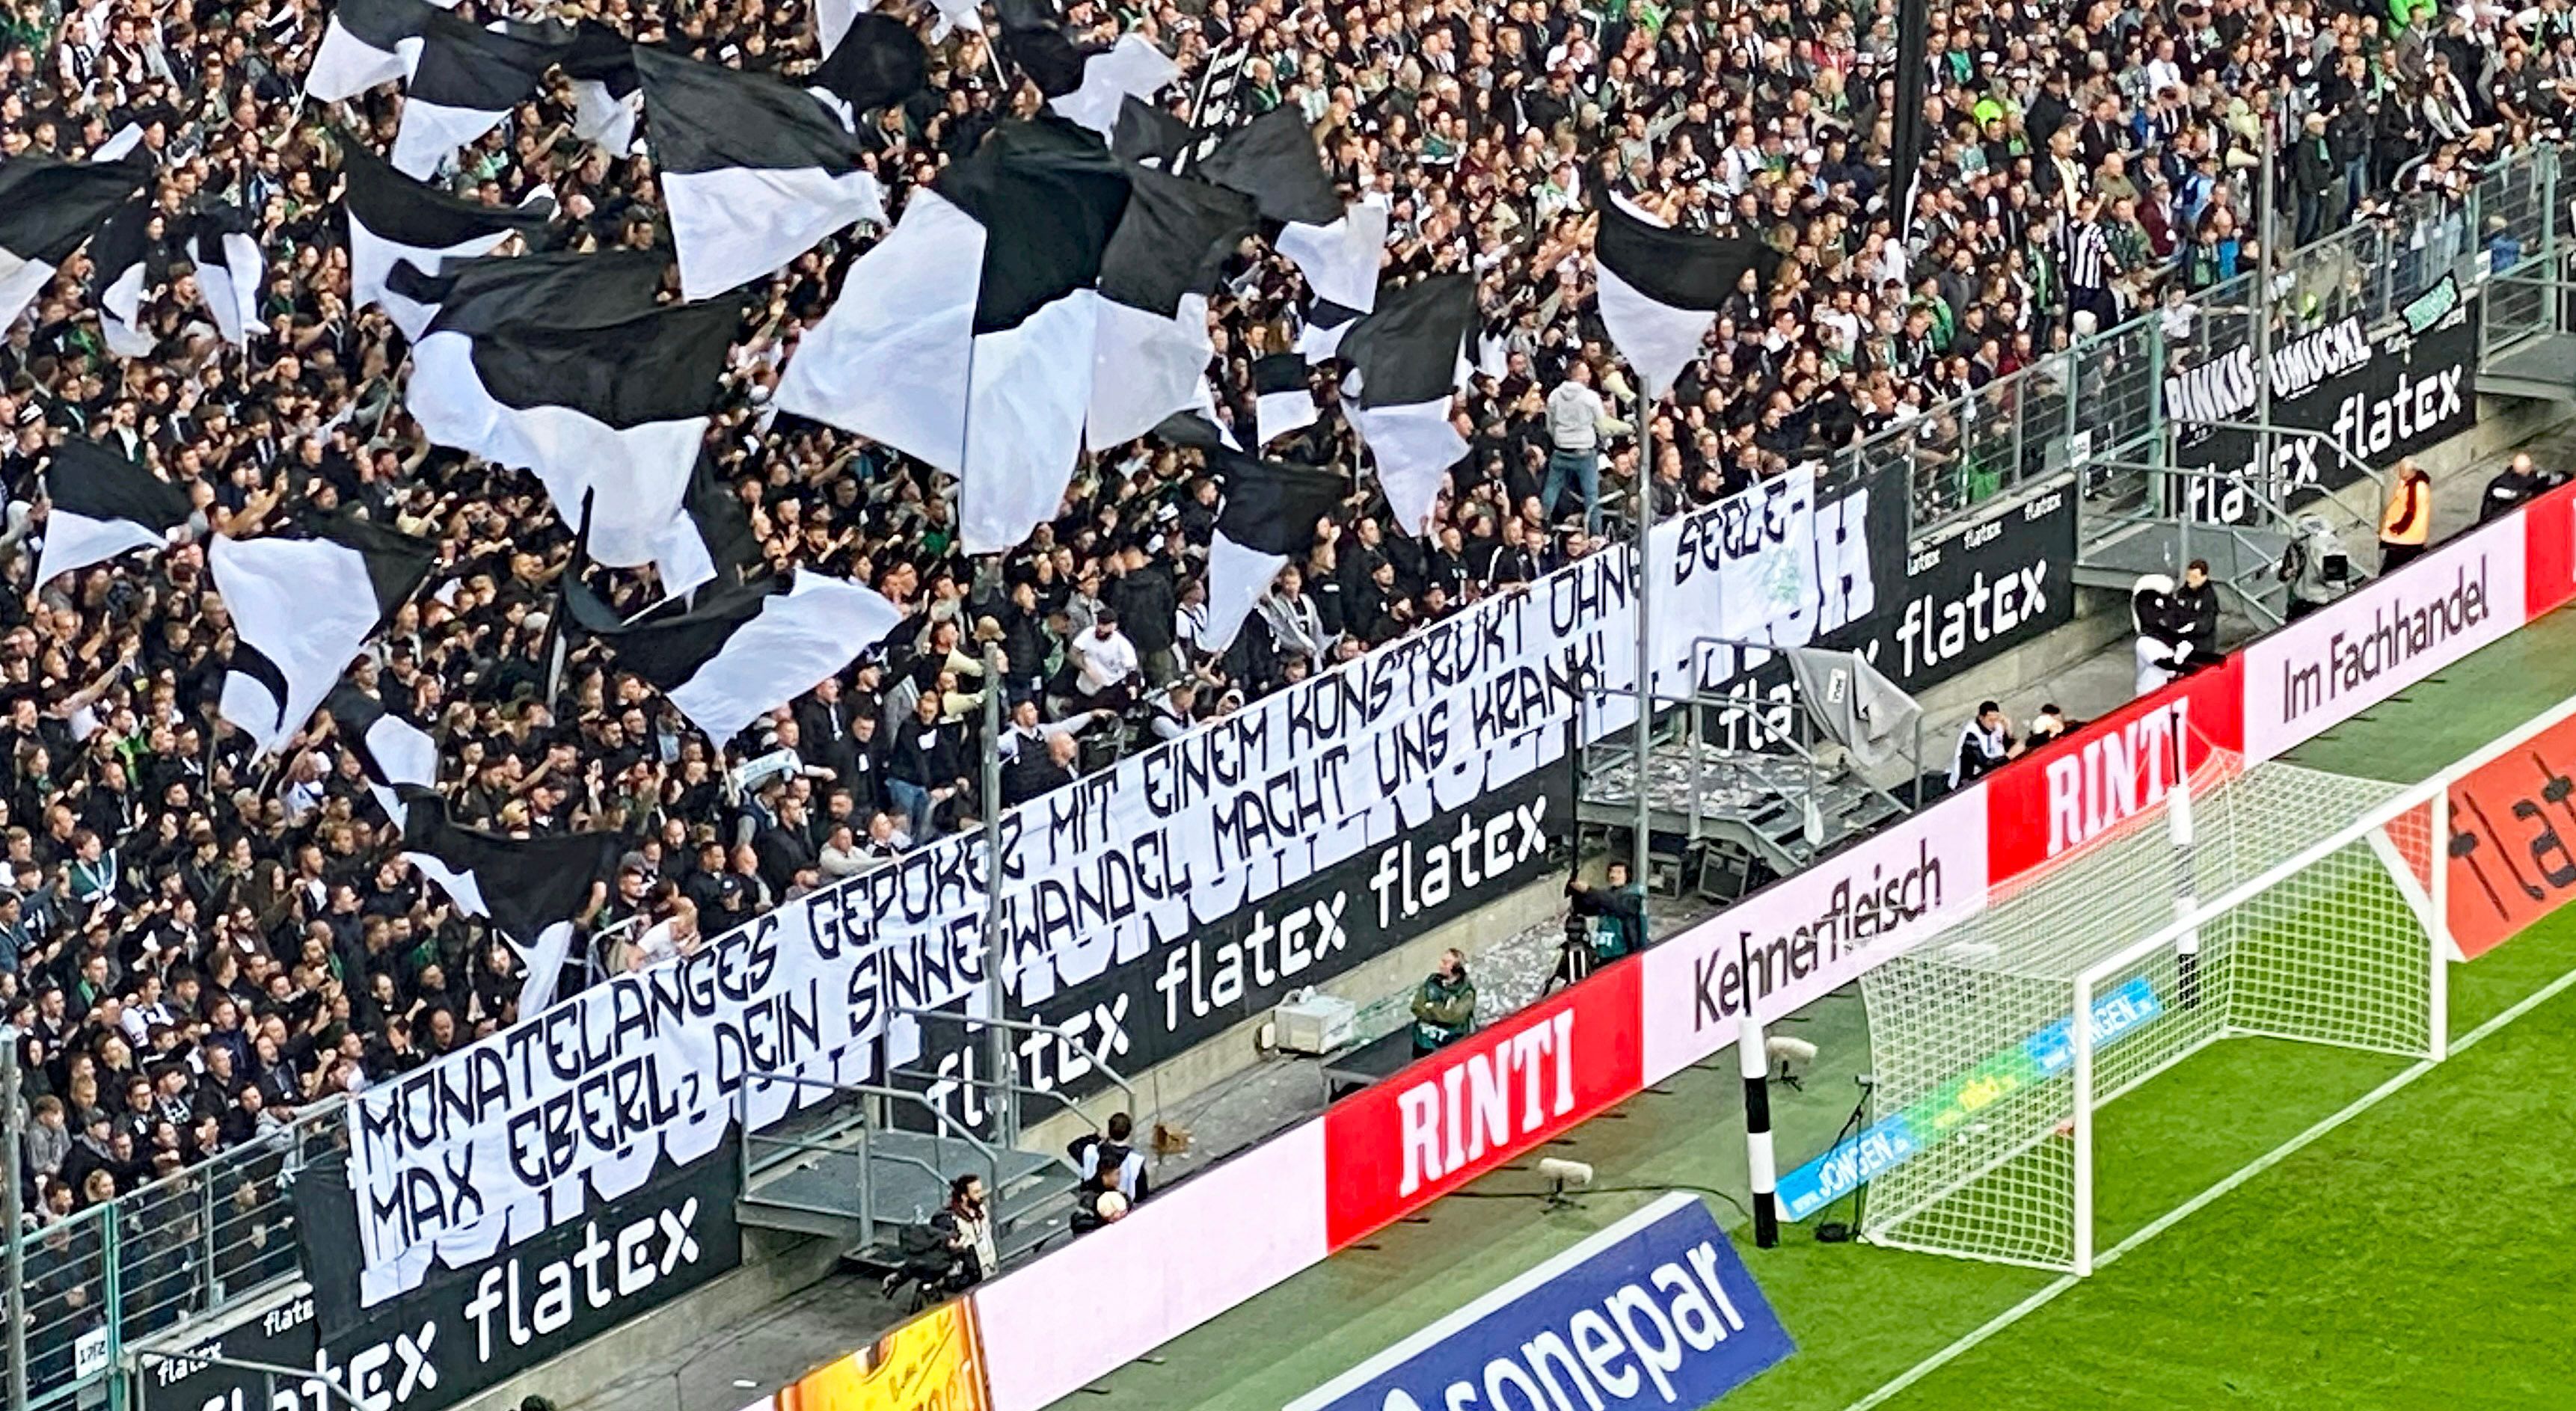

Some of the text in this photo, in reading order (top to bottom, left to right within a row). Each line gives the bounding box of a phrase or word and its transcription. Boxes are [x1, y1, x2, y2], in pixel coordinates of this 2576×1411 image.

[2333, 364, 2462, 469] flatex
[1896, 559, 2046, 677] flatex
[359, 914, 779, 1175] MONATELANGES
[806, 811, 1024, 959] GEPOKER
[1049, 767, 1118, 865] MIT
[1143, 706, 1267, 817] EINEM
[1287, 591, 1531, 760] KONSTRUKT
[1551, 542, 1640, 637] OHNE
[369, 1141, 484, 1261] MAX
[714, 979, 821, 1095] DEIN
[847, 827, 1192, 1037] SINNESWANDEL
[1212, 743, 1349, 873] MACHT
[1374, 698, 1448, 798] UNS
[1472, 630, 1606, 748] KRANK!
[1156, 891, 1346, 1031] flatex
[1370, 796, 1546, 929] flatex
[1397, 553, 2489, 1198] RINTI Kennerfleisch RINTI Im Fachhandel
[198, 1196, 699, 1411] tex flatex
